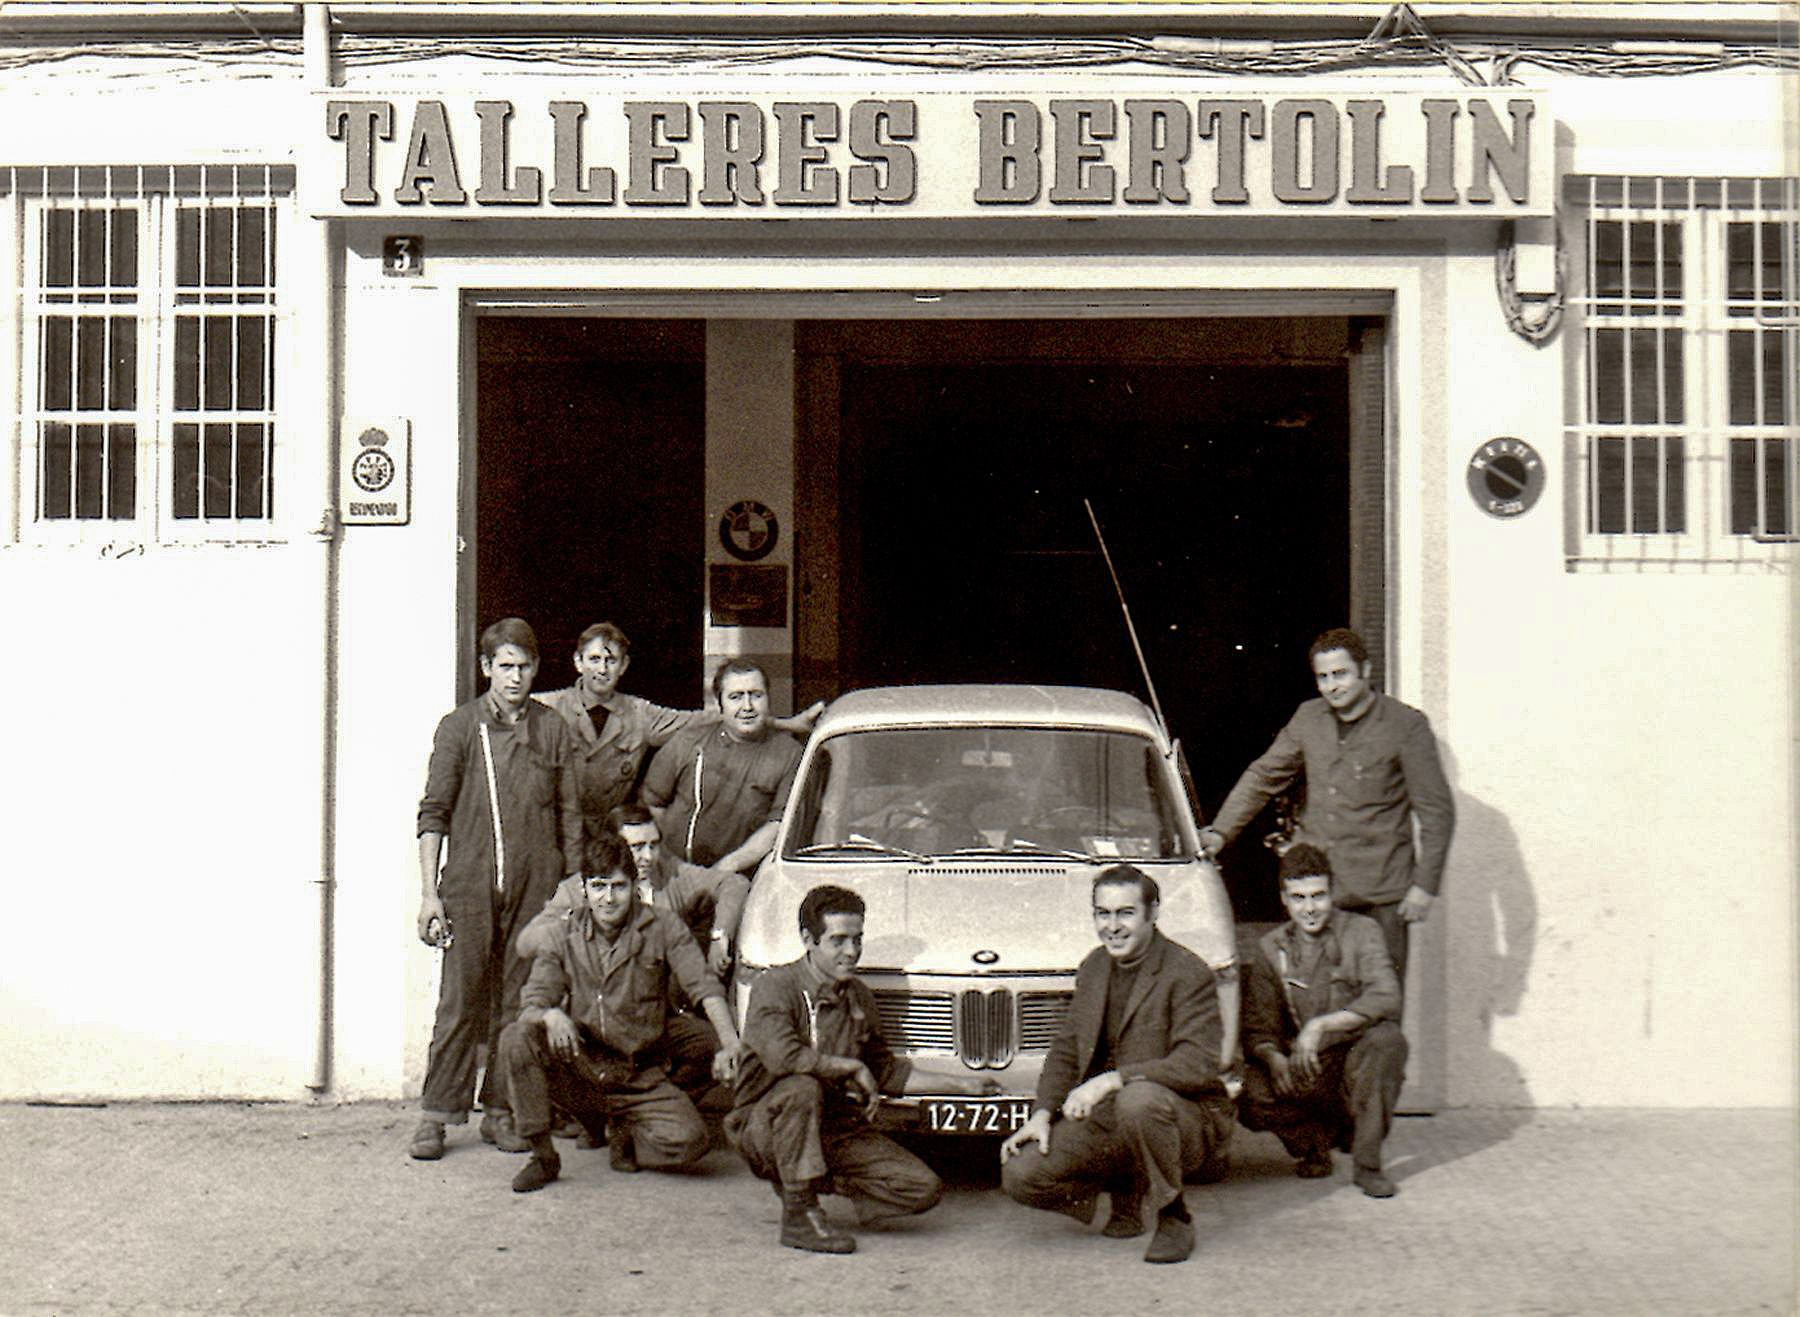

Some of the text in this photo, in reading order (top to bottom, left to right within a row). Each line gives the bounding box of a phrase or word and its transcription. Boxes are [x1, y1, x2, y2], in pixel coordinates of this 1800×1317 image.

[326, 99, 1536, 207] TALLERES BERTOLIN
[395, 239, 411, 272] 3
